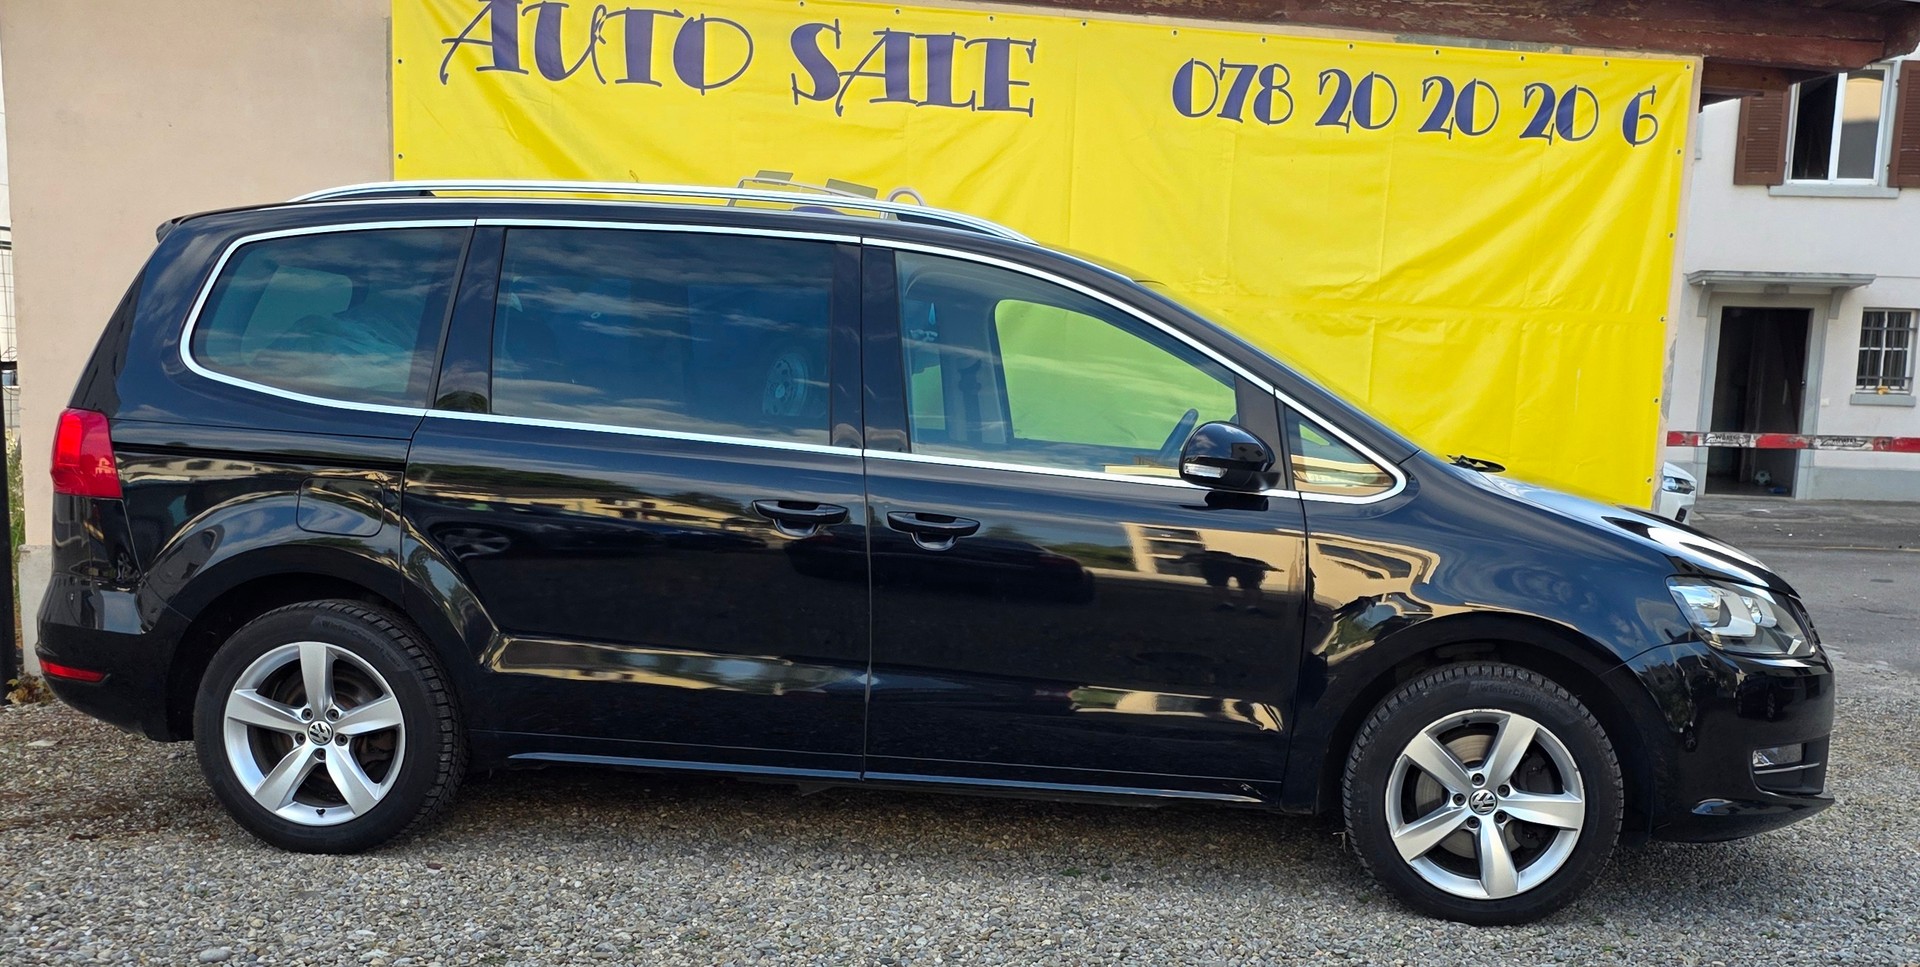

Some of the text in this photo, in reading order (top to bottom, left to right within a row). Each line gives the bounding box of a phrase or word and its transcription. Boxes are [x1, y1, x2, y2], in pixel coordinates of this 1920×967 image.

[440, 0, 1037, 117] AUTO SALE
[1172, 58, 1658, 147] 078 20 20 20 6
